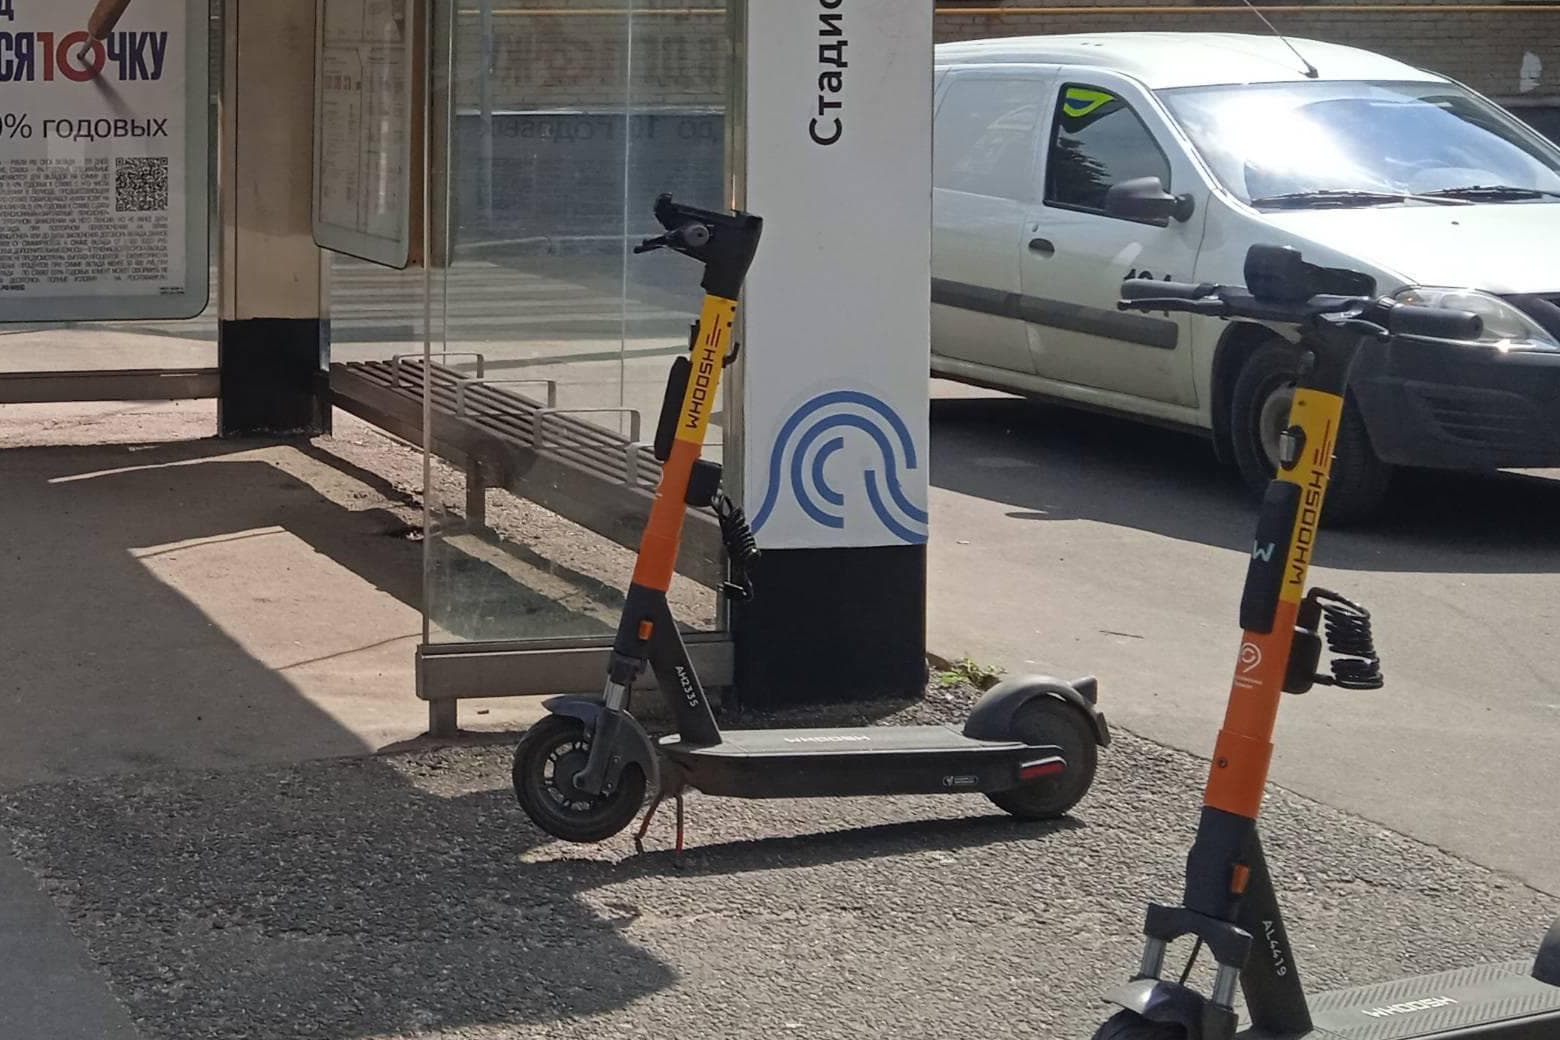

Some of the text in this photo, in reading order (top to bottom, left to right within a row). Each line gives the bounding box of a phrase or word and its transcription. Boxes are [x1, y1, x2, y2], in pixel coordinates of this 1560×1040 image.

[42, 118, 169, 142] годовых
[686, 348, 716, 428] WHOOSH
[1289, 470, 1324, 585] WHOOSH
[1253, 540, 1275, 562] W
[1262, 920, 1287, 978] AL4419
[1361, 995, 1459, 1018] WHOOSH
